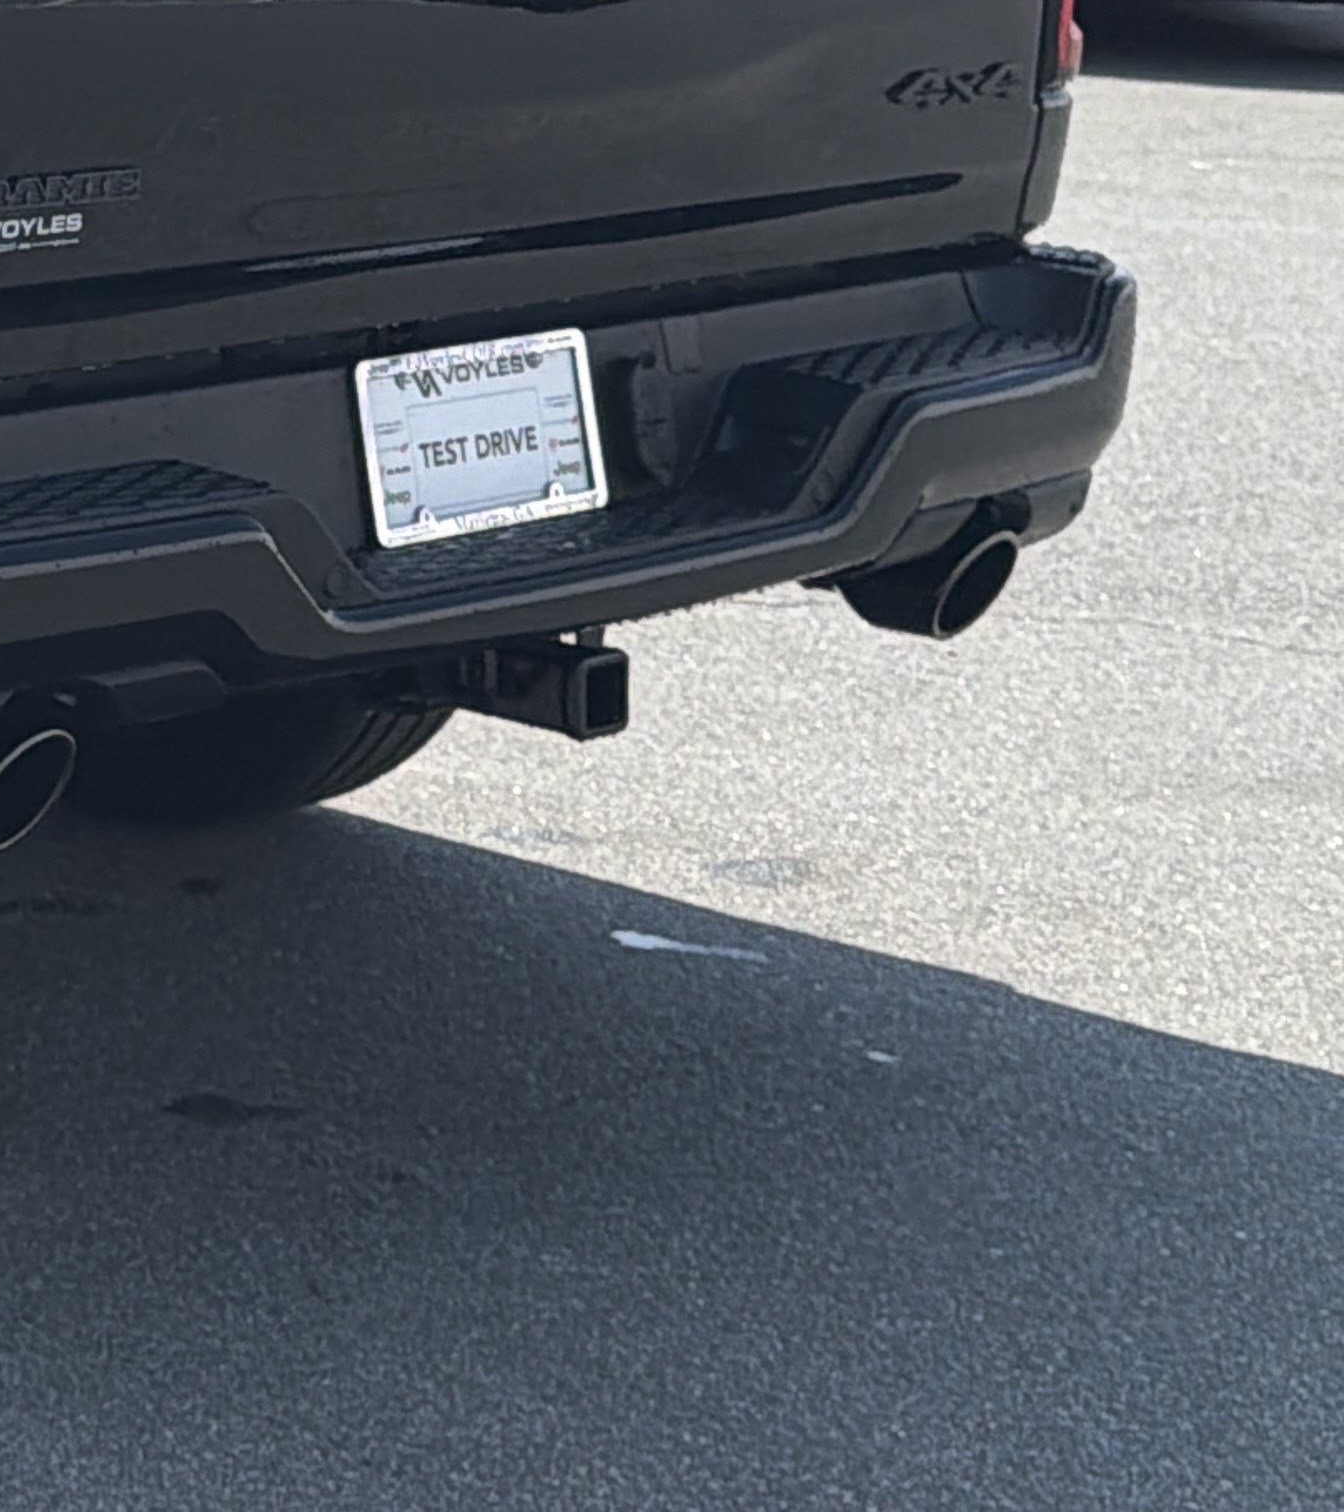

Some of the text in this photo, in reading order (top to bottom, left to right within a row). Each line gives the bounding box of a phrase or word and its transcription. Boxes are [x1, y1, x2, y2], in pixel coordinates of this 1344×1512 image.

[439, 355, 526, 385] VOYLES
[418, 425, 540, 469] TEST DRIVE
